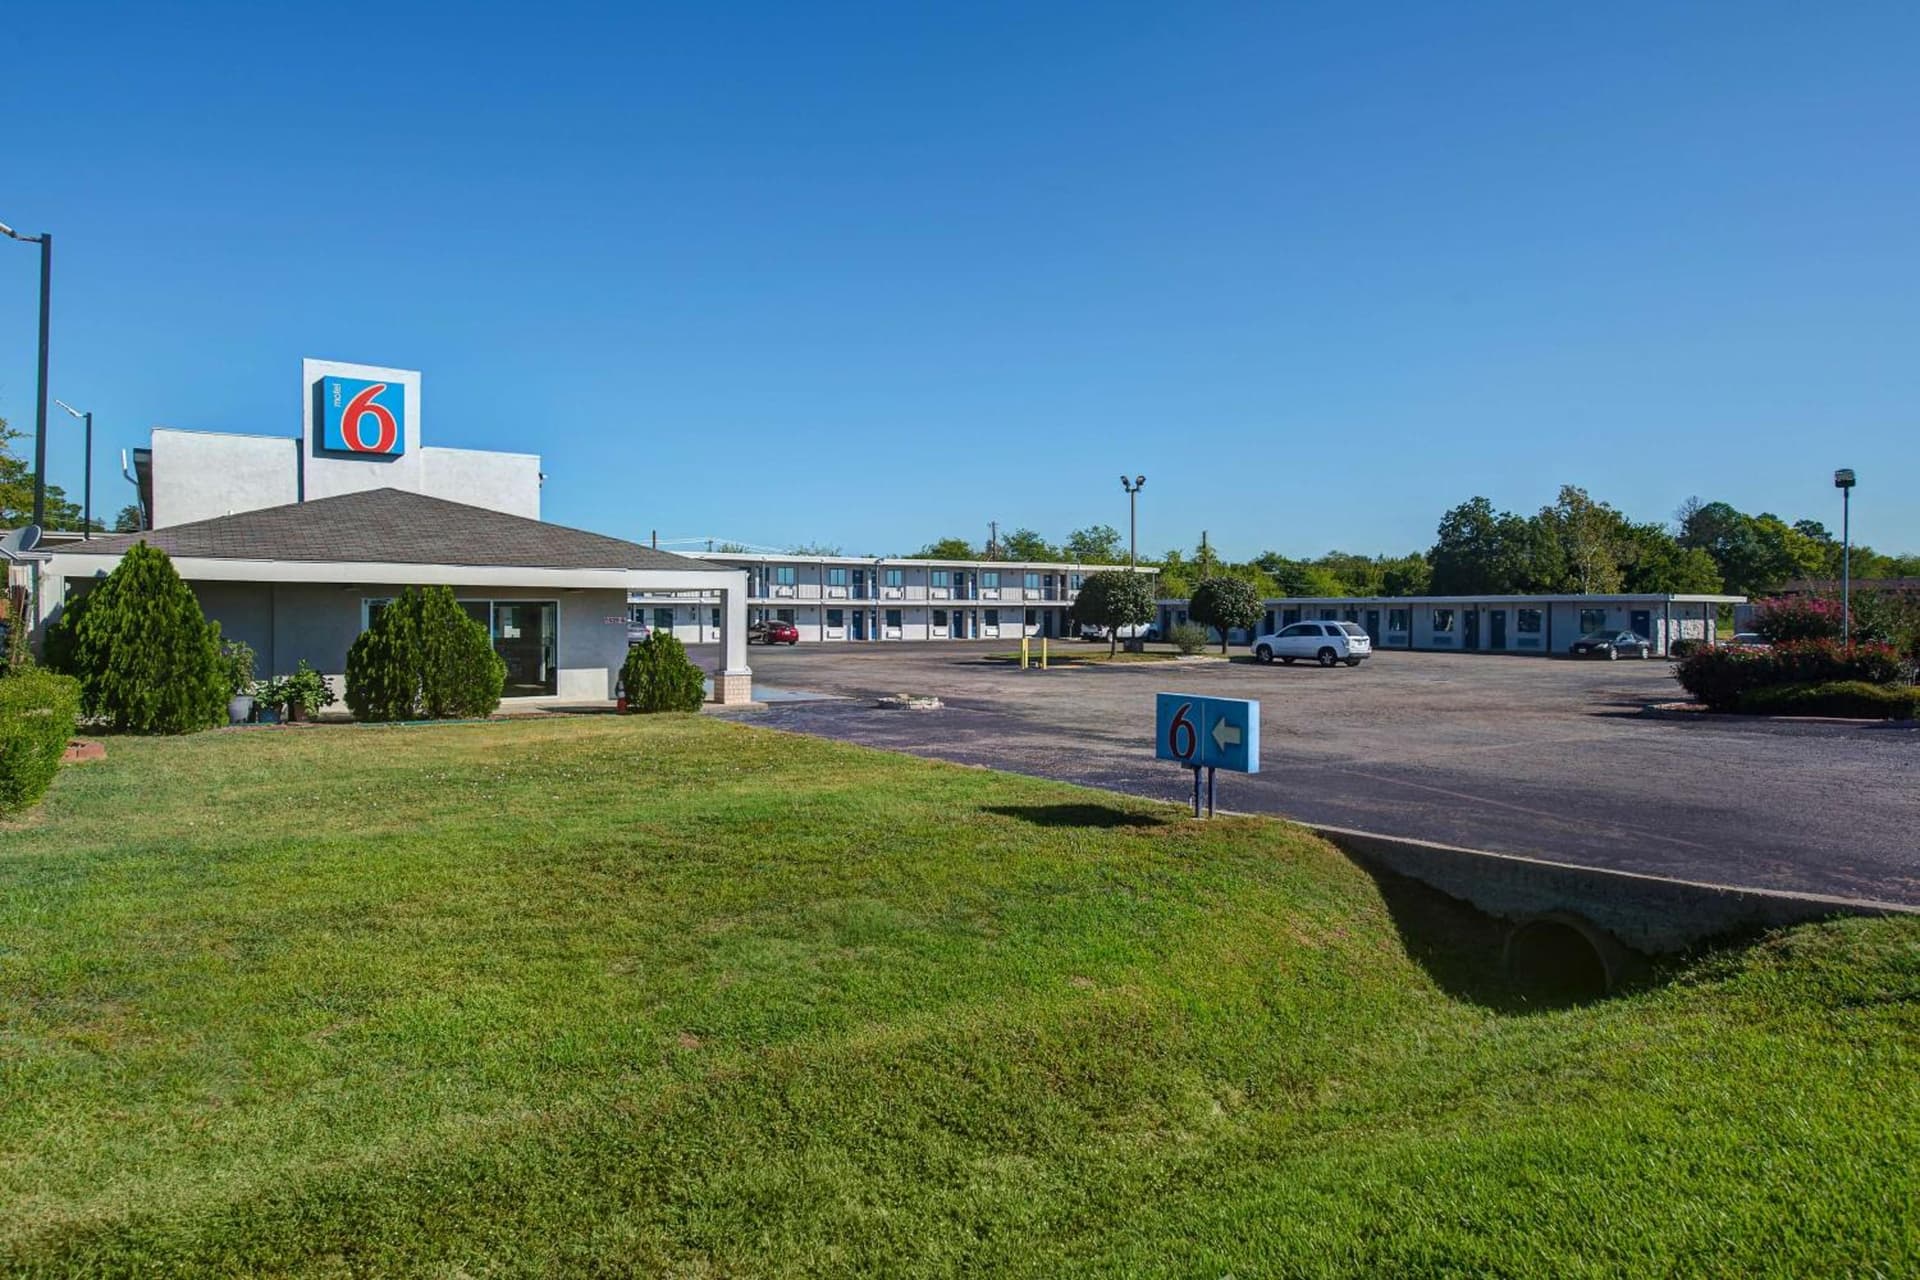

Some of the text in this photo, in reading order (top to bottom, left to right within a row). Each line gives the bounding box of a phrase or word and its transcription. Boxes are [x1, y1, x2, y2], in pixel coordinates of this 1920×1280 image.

[332, 383, 342, 408] motel
[341, 383, 398, 454] 6
[1168, 702, 1198, 760] 6
